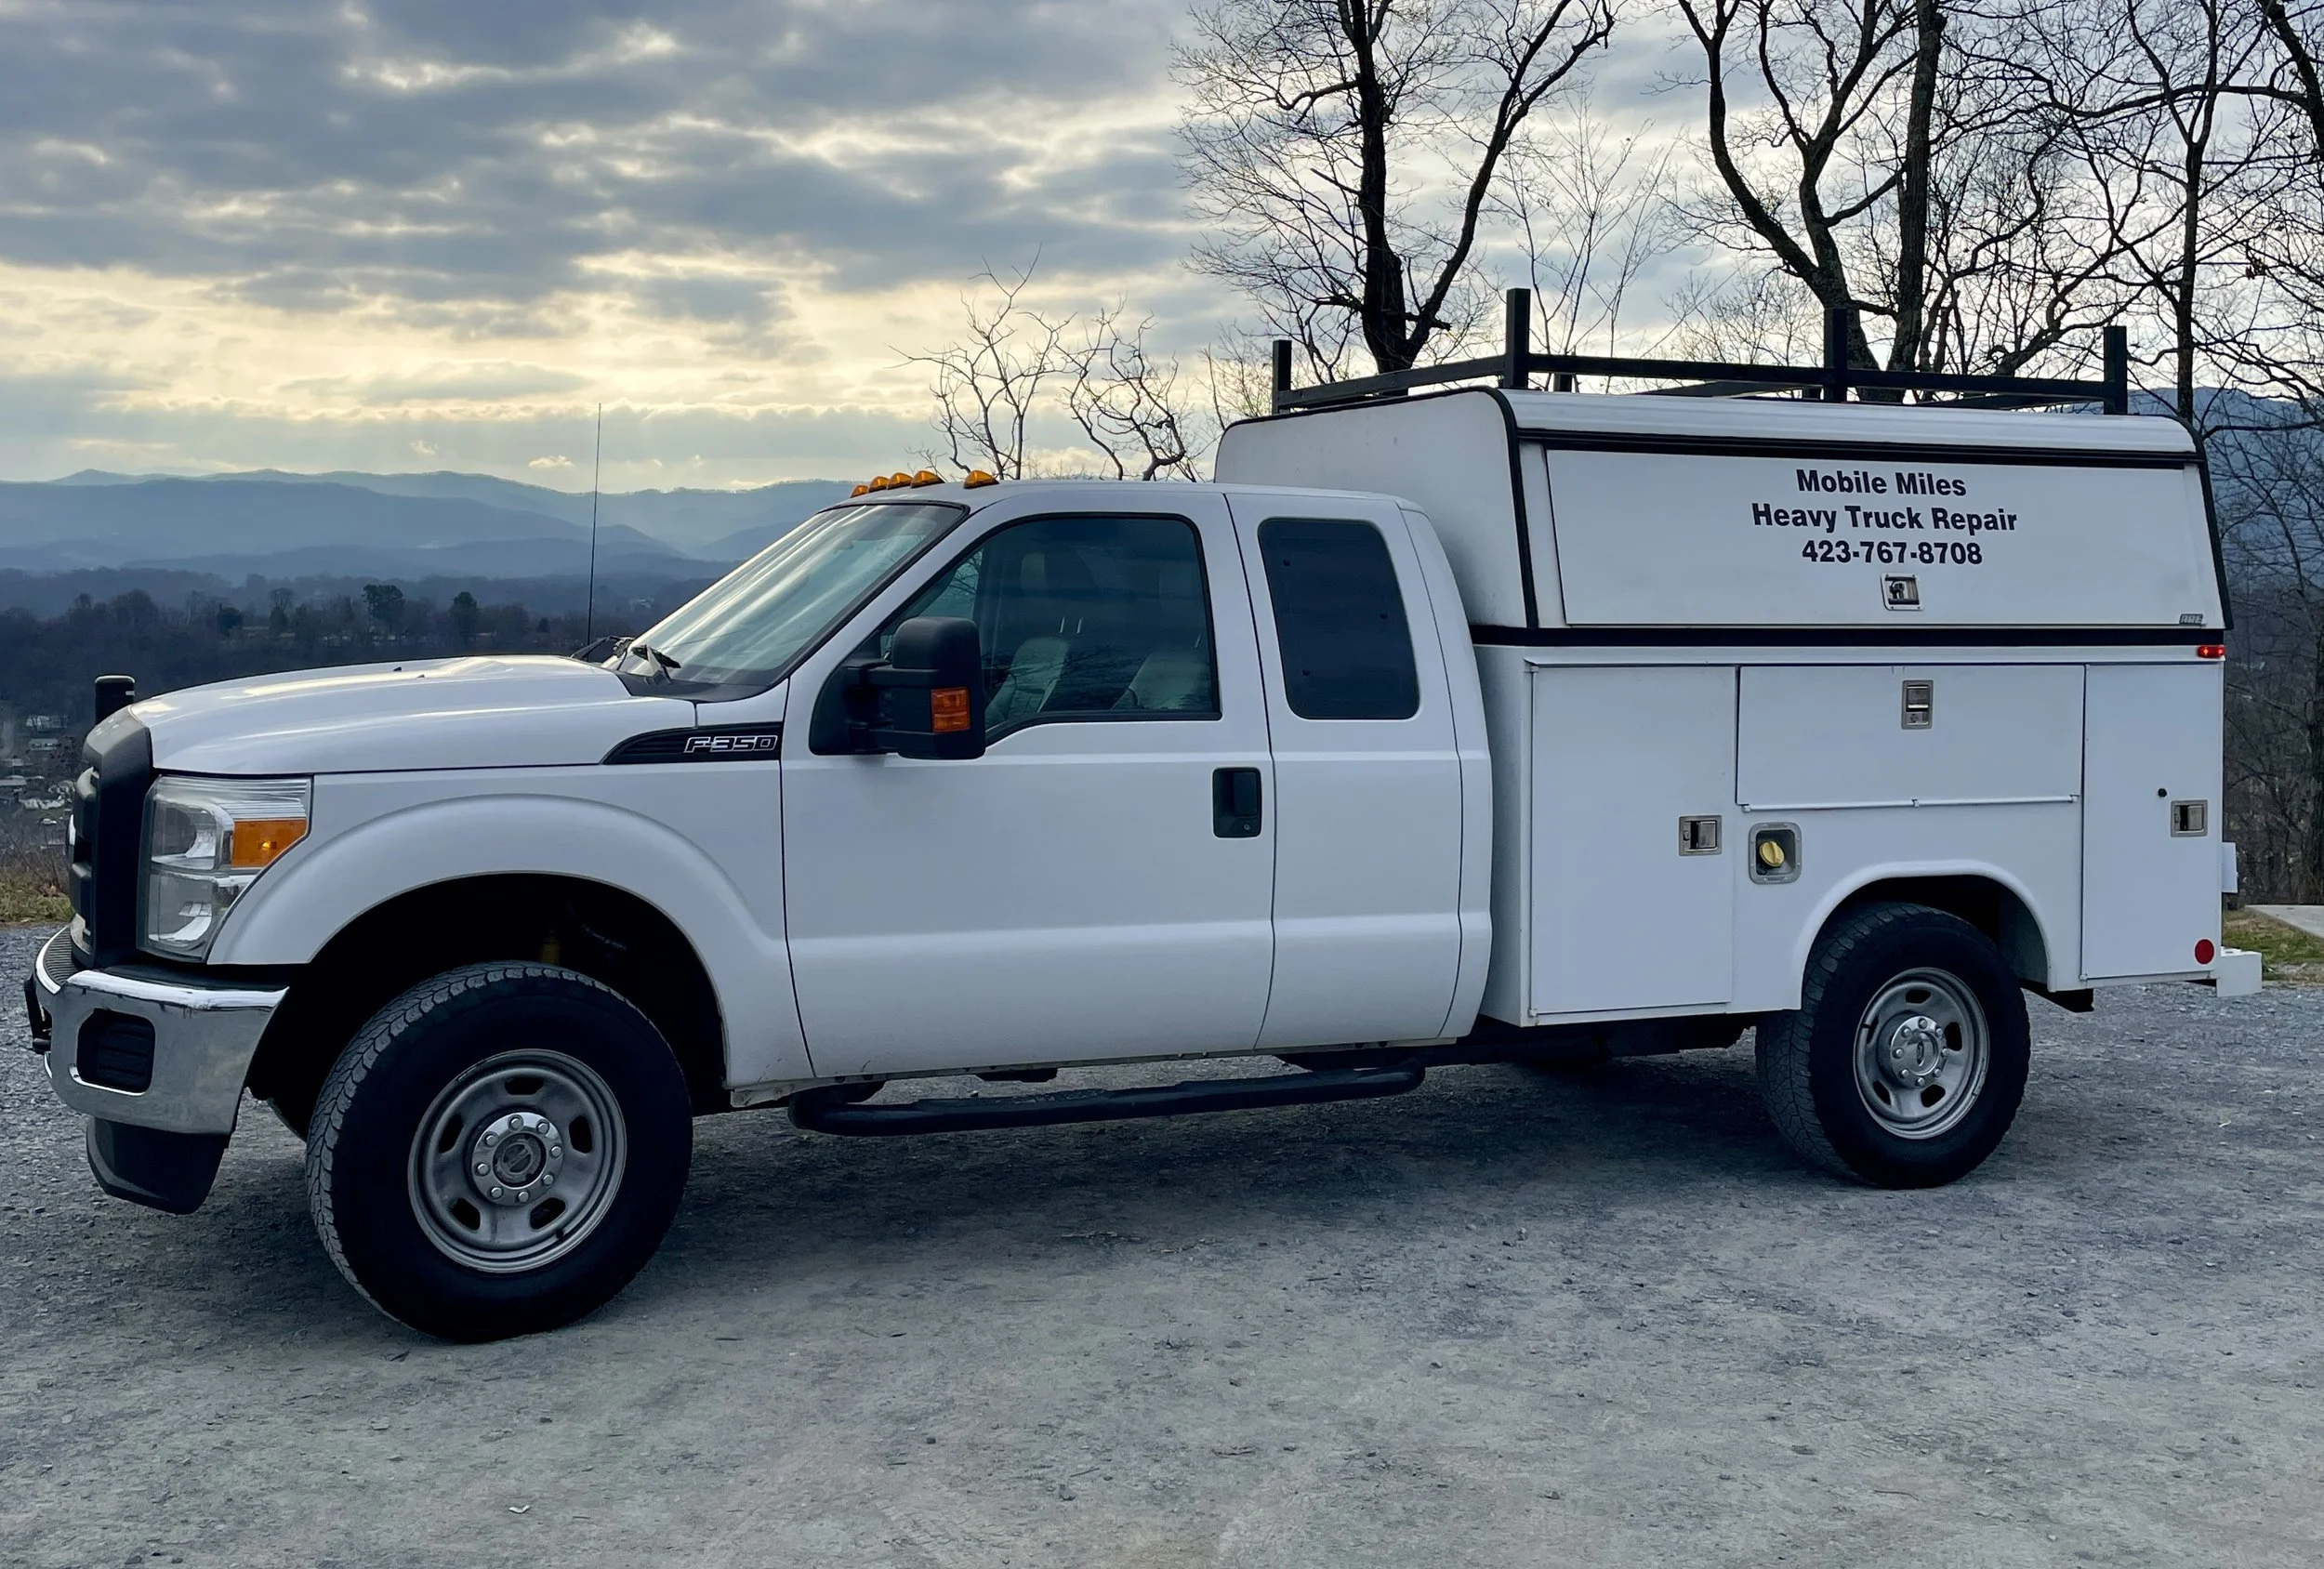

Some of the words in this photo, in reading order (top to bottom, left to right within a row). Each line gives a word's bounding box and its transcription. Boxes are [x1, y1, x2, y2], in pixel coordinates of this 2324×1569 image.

[1796, 468, 1887, 494] Mobile
[1895, 472, 1967, 497] Miles
[1751, 503, 1837, 534] Heavy
[1844, 505, 1924, 530] Truck
[1933, 508, 2018, 536] Repair
[1802, 539, 1983, 565] 423-767-8708
[683, 735, 778, 754] F-350
